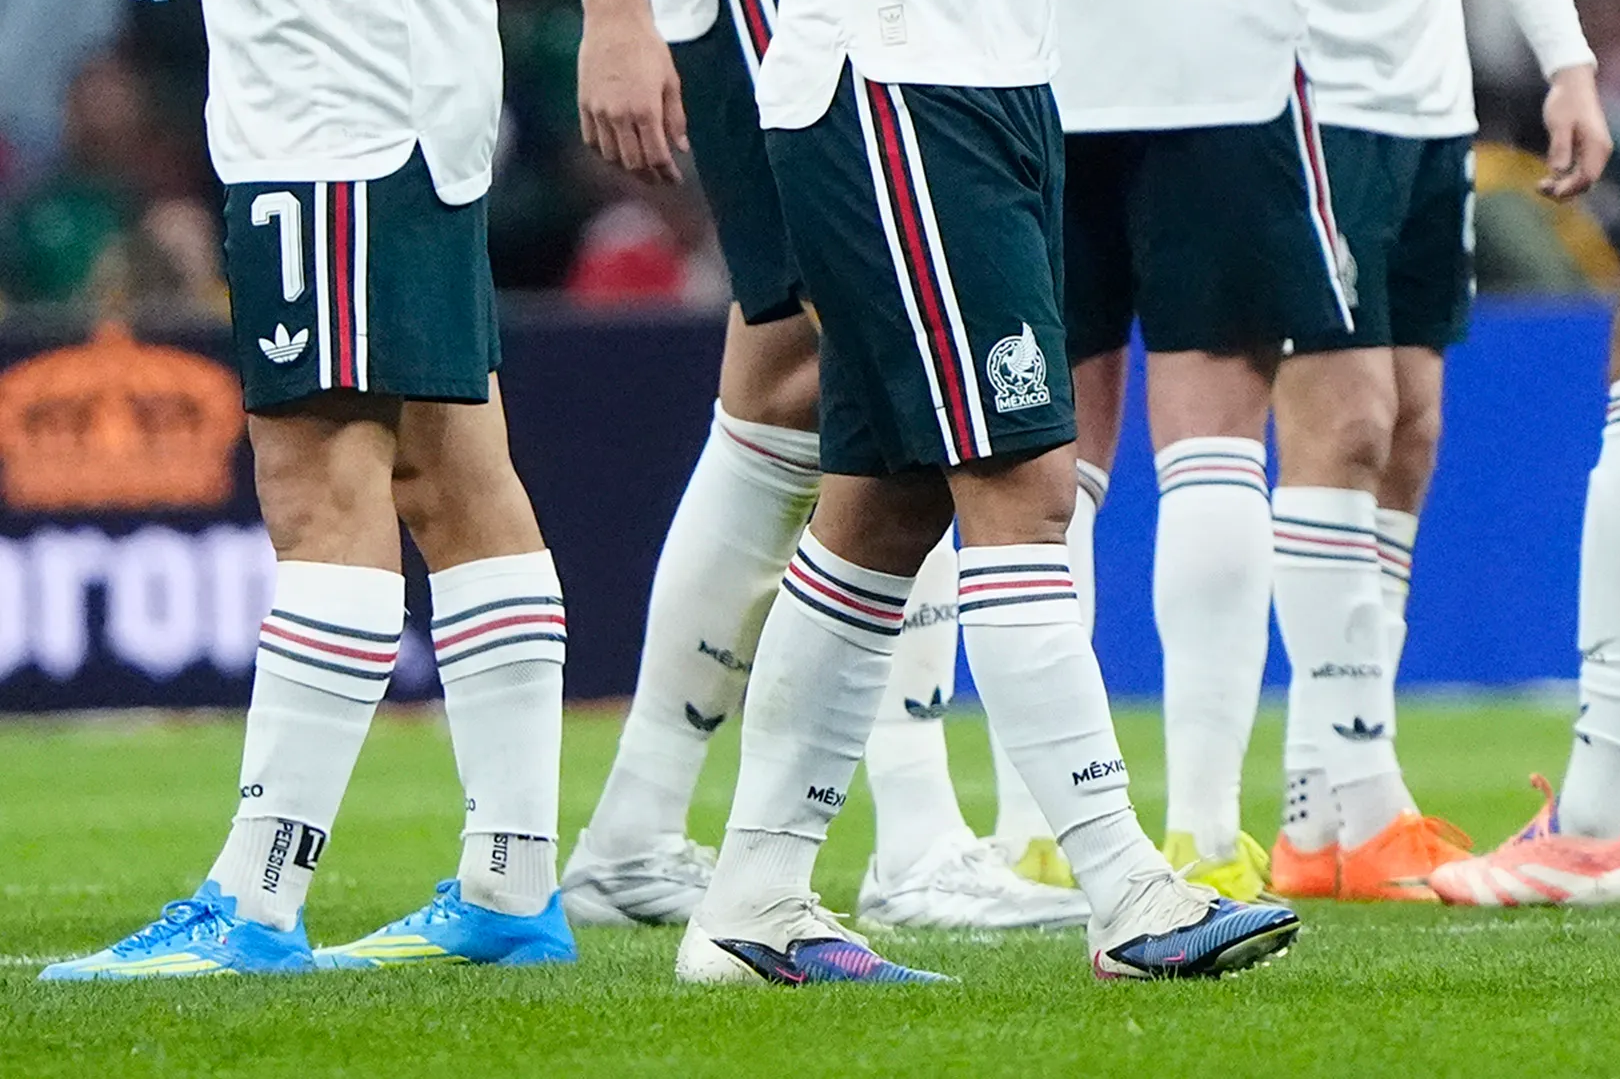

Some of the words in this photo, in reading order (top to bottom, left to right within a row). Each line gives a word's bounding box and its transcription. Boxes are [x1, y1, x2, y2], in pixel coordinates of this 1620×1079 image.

[251, 191, 304, 302] 7
[998, 389, 1047, 410] MÉXICO
[261, 819, 294, 894] PEDESIGN
